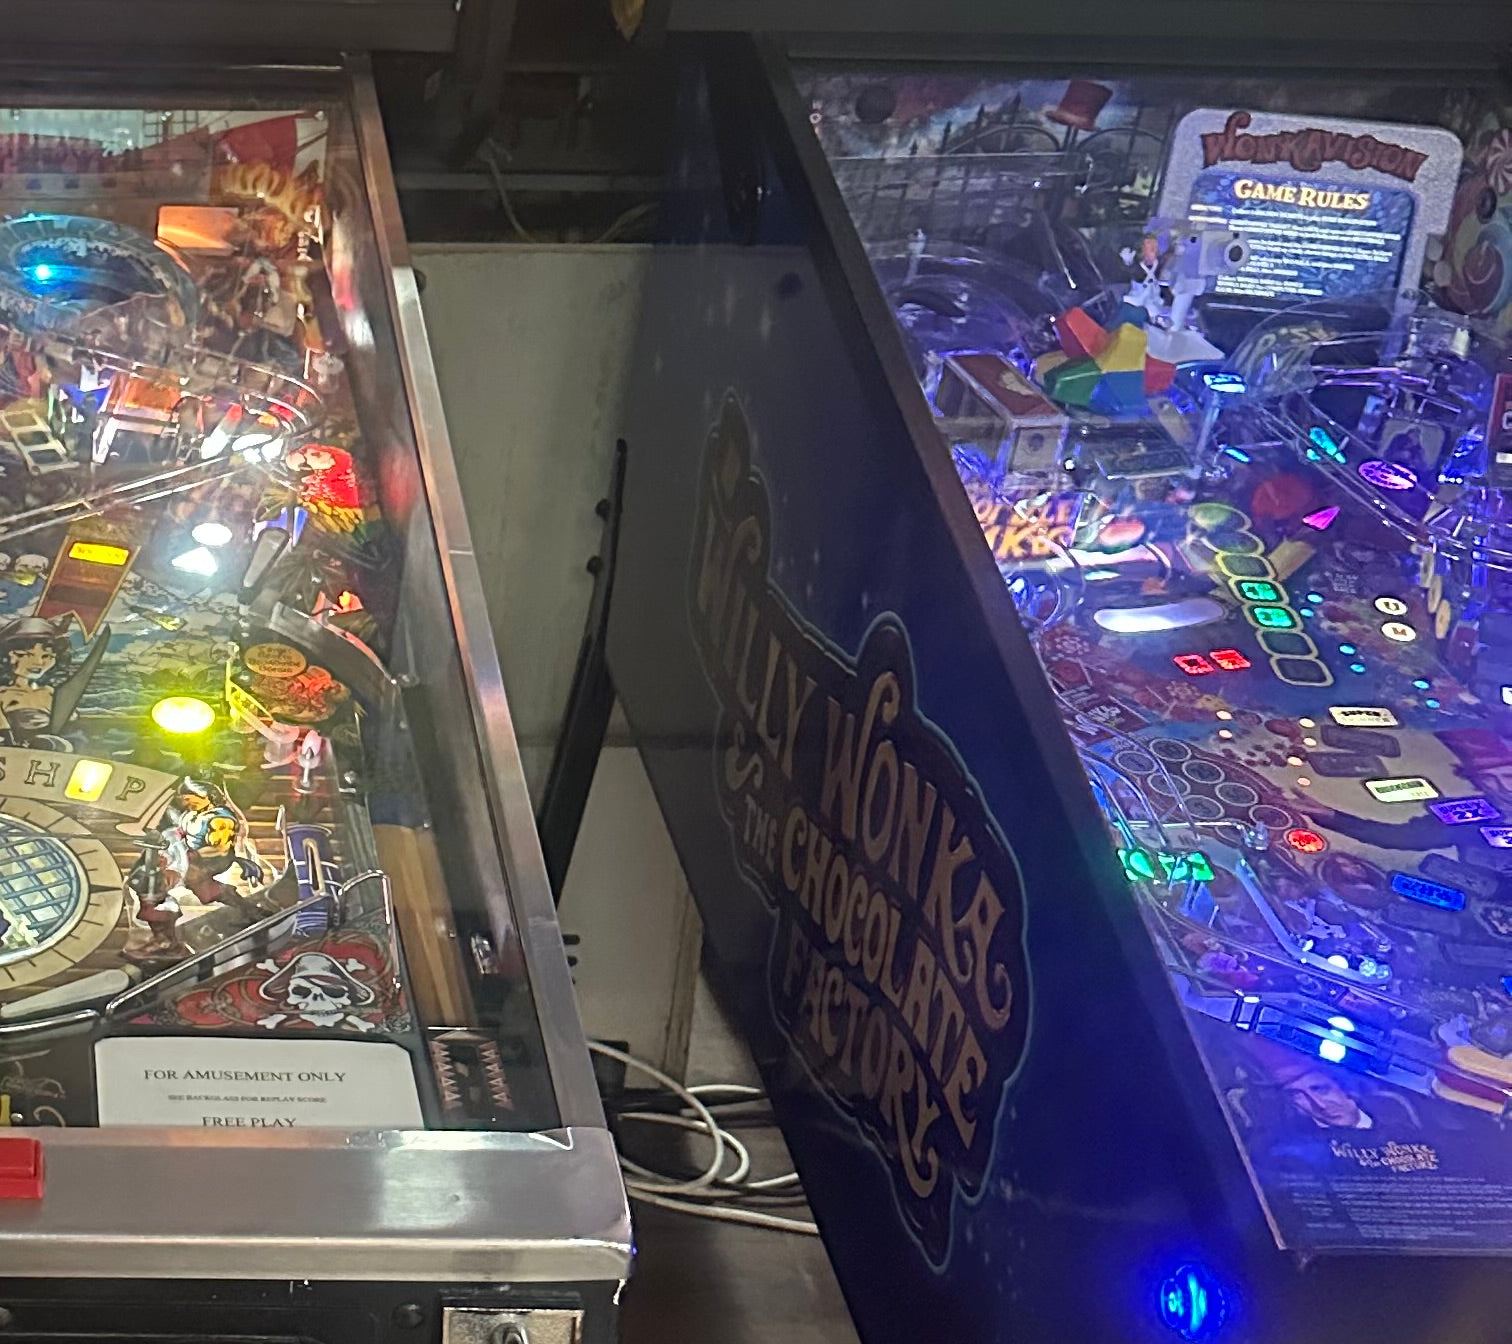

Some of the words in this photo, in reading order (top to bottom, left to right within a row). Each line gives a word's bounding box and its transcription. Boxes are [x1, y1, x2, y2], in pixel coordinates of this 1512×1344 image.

[1202, 111, 1429, 183] WONKAVISION
[1234, 179, 1297, 202] GAME
[1298, 187, 1371, 211] RULES
[820, 671, 1012, 1032] WONKA
[781, 805, 988, 1148] CHOCOLATE
[144, 1069, 178, 1081] FOR
[183, 1070, 293, 1082] AMUSEMENT
[298, 1071, 346, 1082] ONLY
[202, 1116, 246, 1127] FREE
[251, 1117, 297, 1128] PLAY
